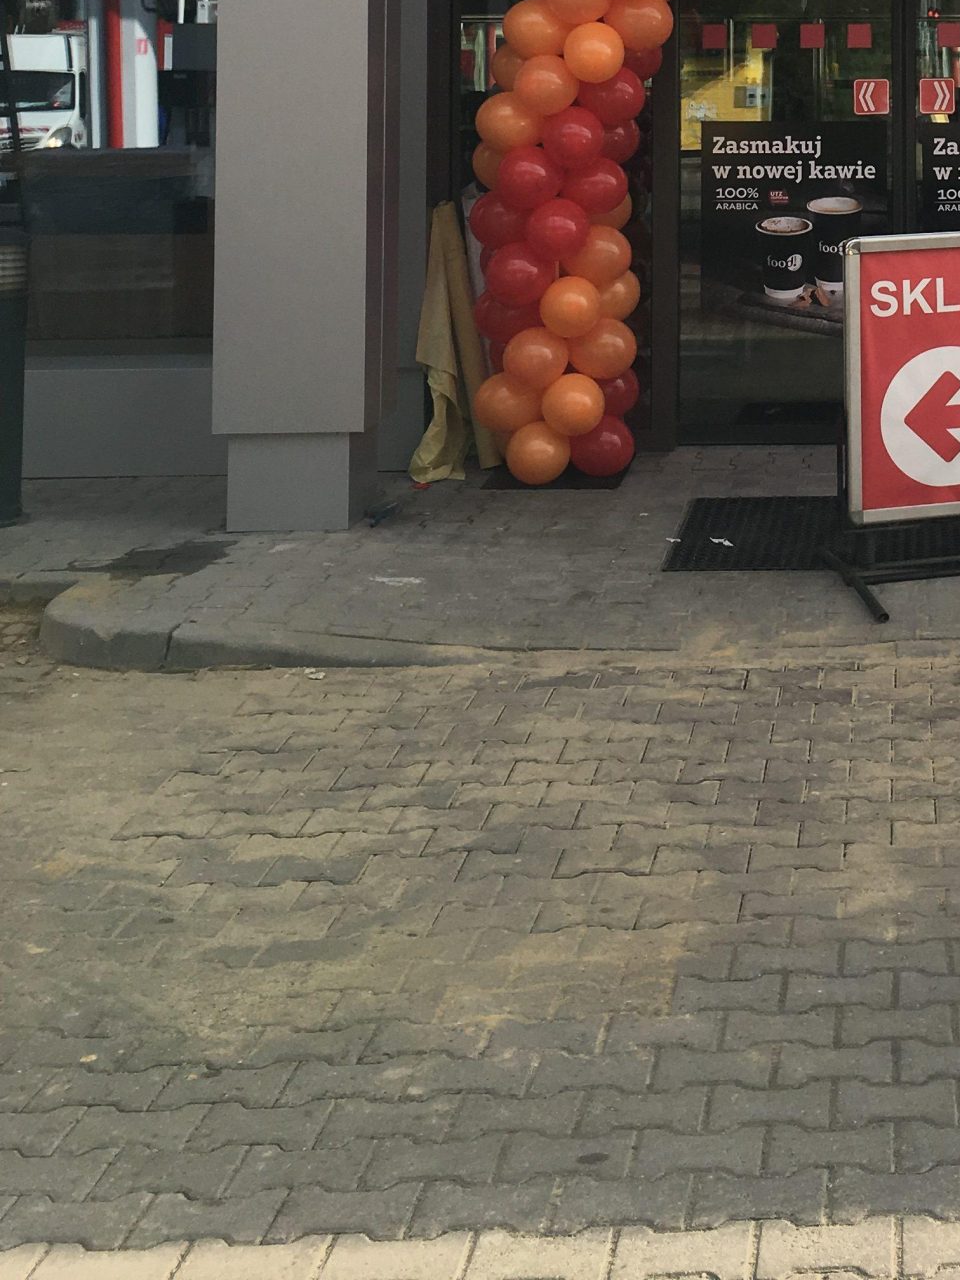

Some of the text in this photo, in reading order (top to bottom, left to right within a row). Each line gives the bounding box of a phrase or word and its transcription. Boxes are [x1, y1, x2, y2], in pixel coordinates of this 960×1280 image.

[712, 135, 822, 158] Zasmakuj
[712, 161, 876, 183] w nowej kawie
[933, 167, 952, 180] w
[715, 188, 759, 199] 100%
